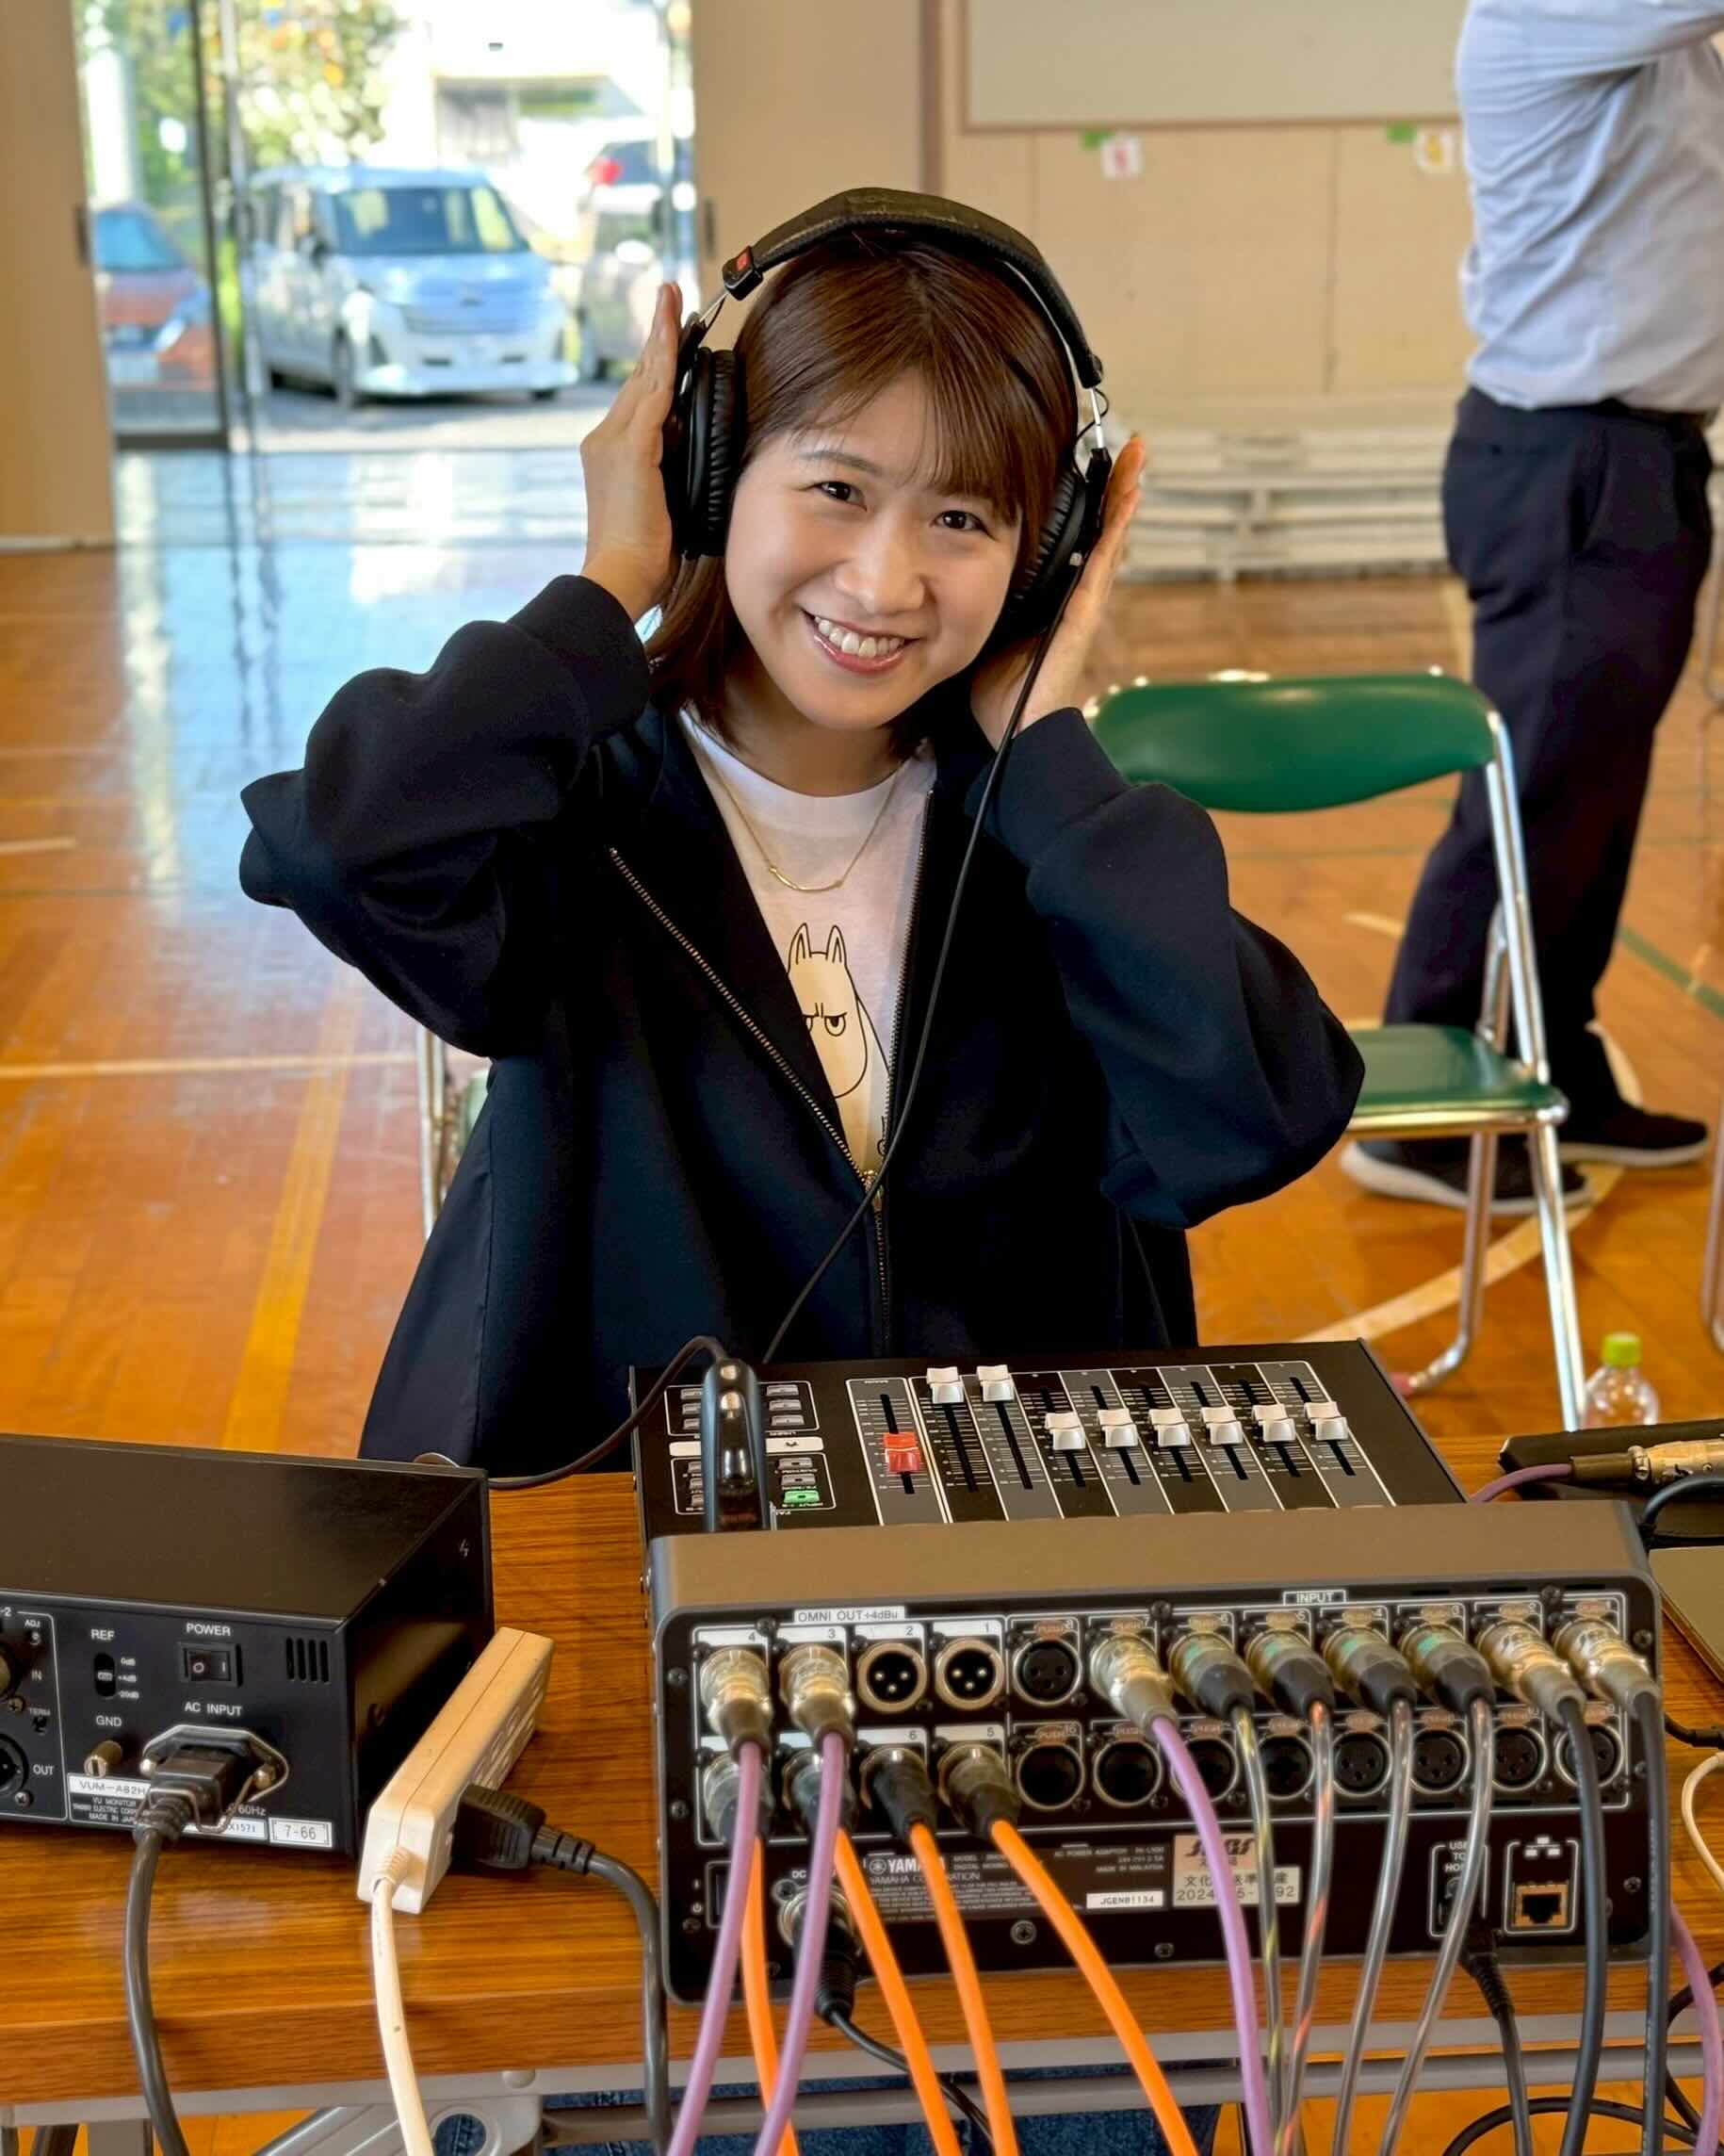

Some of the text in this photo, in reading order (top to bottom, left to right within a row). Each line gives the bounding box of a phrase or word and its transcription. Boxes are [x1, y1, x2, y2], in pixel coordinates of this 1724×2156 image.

[1296, 1592, 1335, 1604] INPUT
[798, 1611, 831, 1623] OMNI
[90, 1628, 115, 1641] REF
[186, 1622, 232, 1637] POWER
[828, 1628, 837, 1640] 3
[904, 1625, 914, 1637] 2
[748, 1632, 756, 1642] 4
[31, 1670, 43, 1681] IN
[184, 1701, 242, 1718] AC INPUT
[95, 1715, 122, 1727] GND
[909, 1729, 917, 1740] 6
[32, 1763, 55, 1775] OUT
[285, 1824, 317, 1840] 7-66
